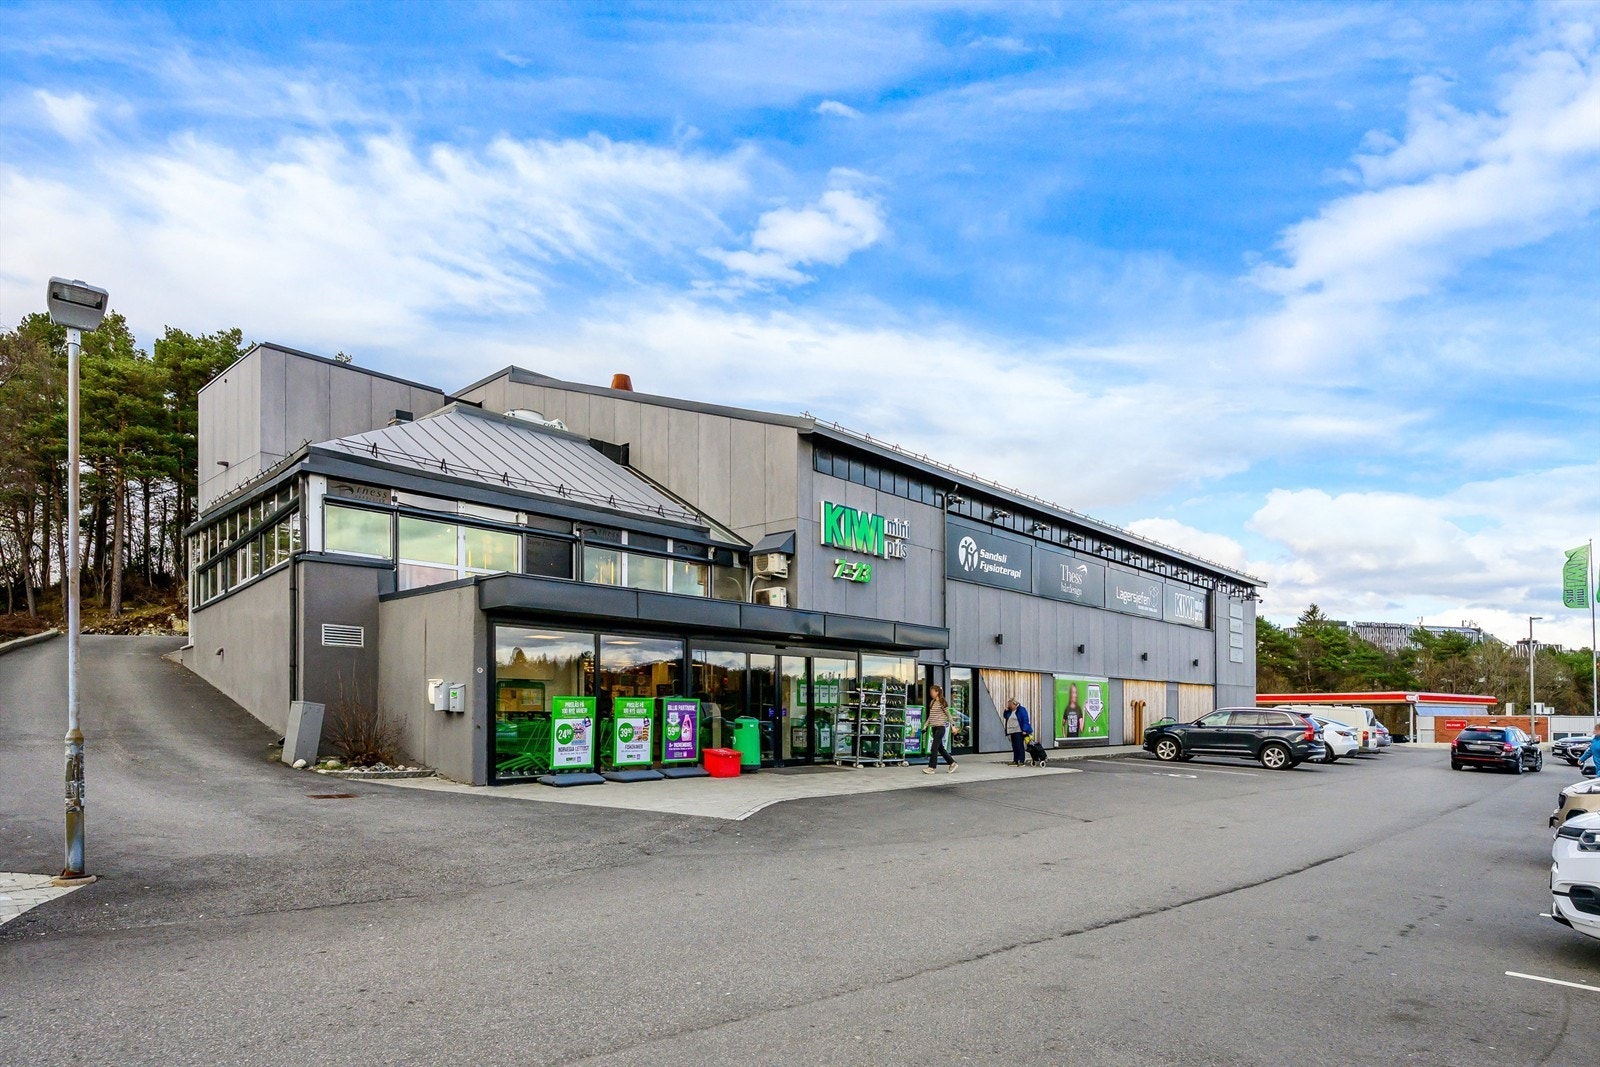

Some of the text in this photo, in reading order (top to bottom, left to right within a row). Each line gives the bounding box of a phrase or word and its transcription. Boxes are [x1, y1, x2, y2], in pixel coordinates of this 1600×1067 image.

[821, 500, 885, 558] KIWI
[886, 518, 910, 539] mini
[886, 539, 908, 559] pris
[980, 548, 1008, 563] Sandsli
[980, 560, 1022, 580] Fysioterapi
[1060, 563, 1083, 585] Thess
[1174, 592, 1195, 620] KIWI
[1564, 589, 1574, 604] pris
[1577, 588, 1585, 606] mini
